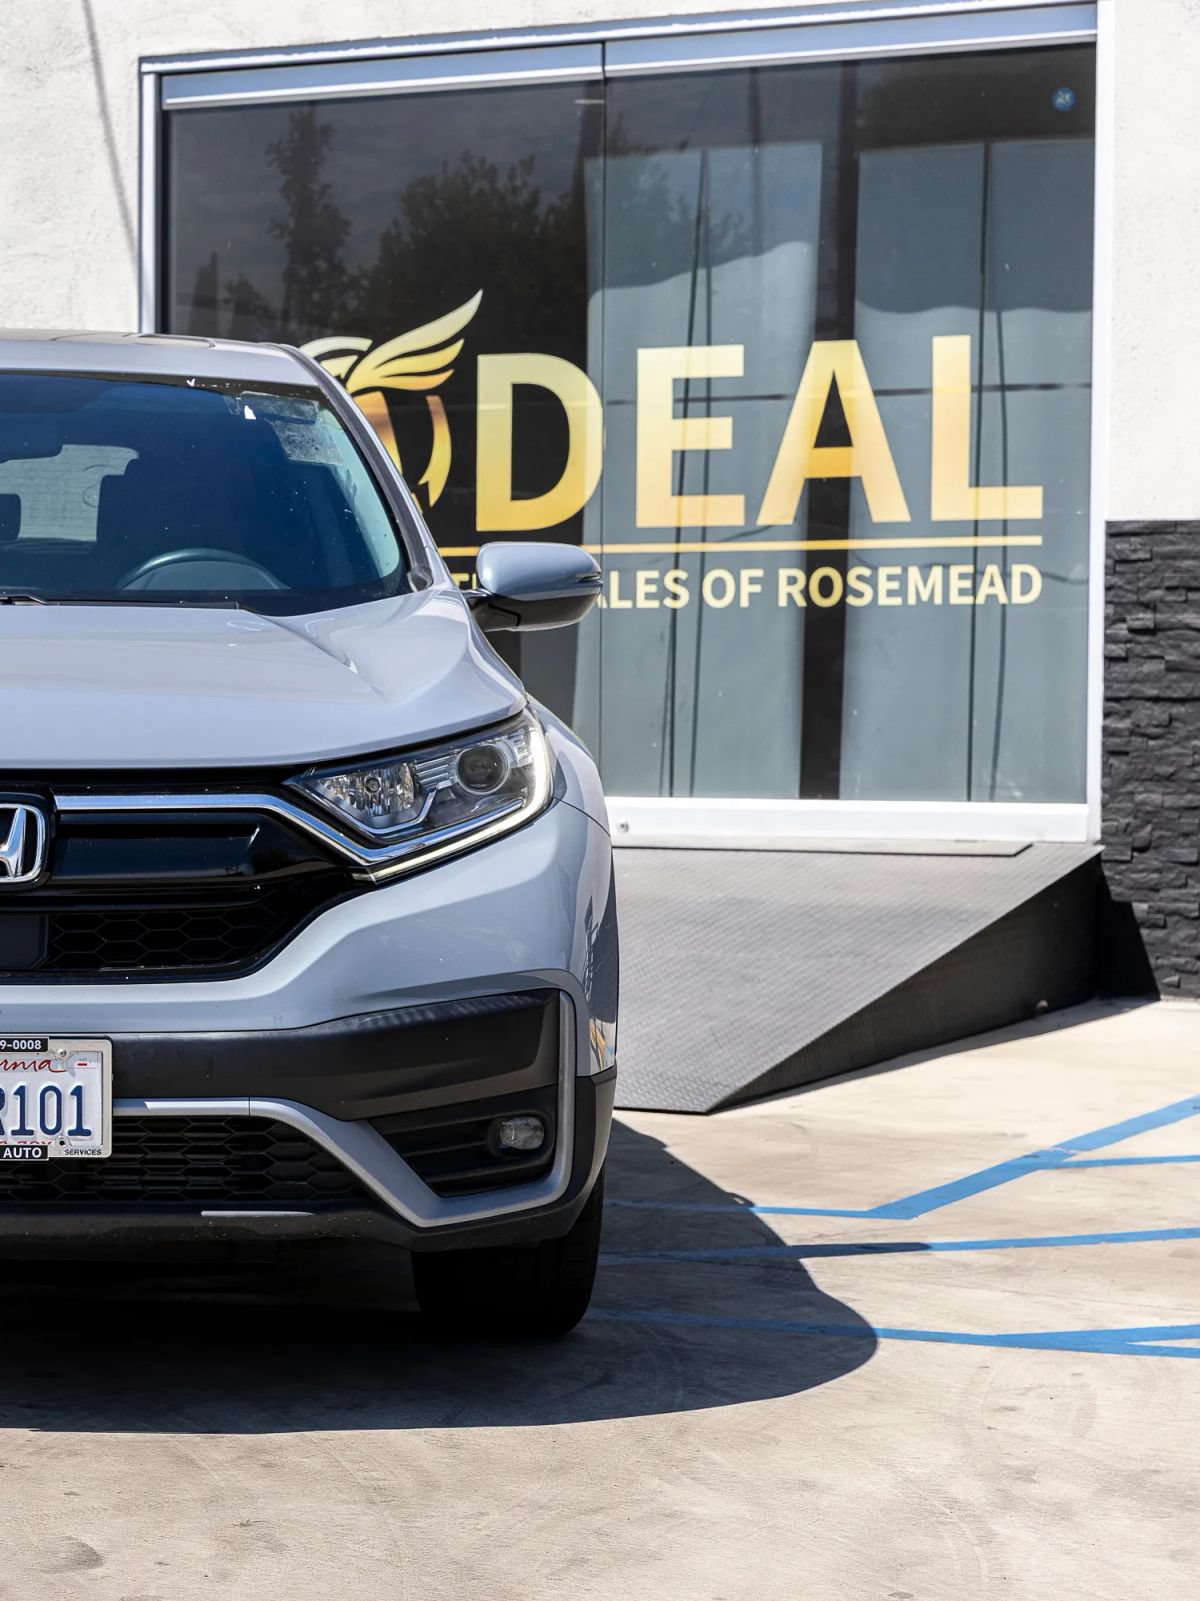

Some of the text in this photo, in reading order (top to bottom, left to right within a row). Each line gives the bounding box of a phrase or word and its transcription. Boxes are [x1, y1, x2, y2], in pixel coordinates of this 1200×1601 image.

[596, 563, 1043, 609] LES OF ROSEMEAD
[3, 1147, 42, 1158] AUTO
